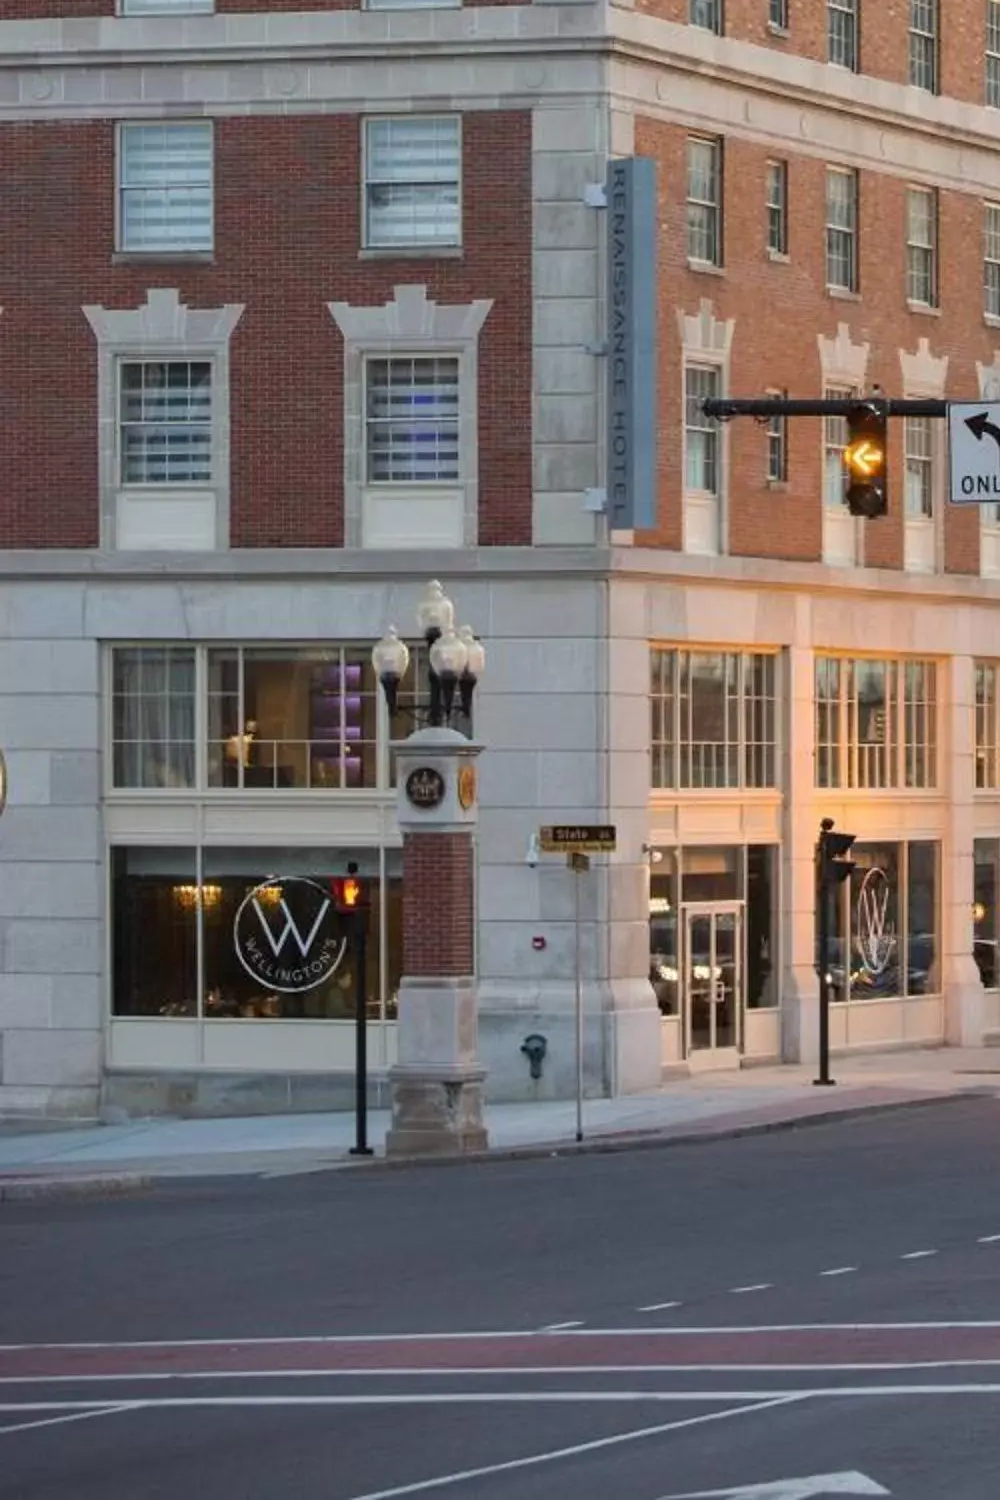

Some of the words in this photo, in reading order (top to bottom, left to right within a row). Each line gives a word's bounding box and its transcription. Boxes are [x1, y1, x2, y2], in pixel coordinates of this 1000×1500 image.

[612, 168, 626, 397] RENAISSANCE
[612, 412, 627, 522] HOTEL
[245, 936, 338, 982] WELLINGTON'S
[252, 897, 331, 958] W
